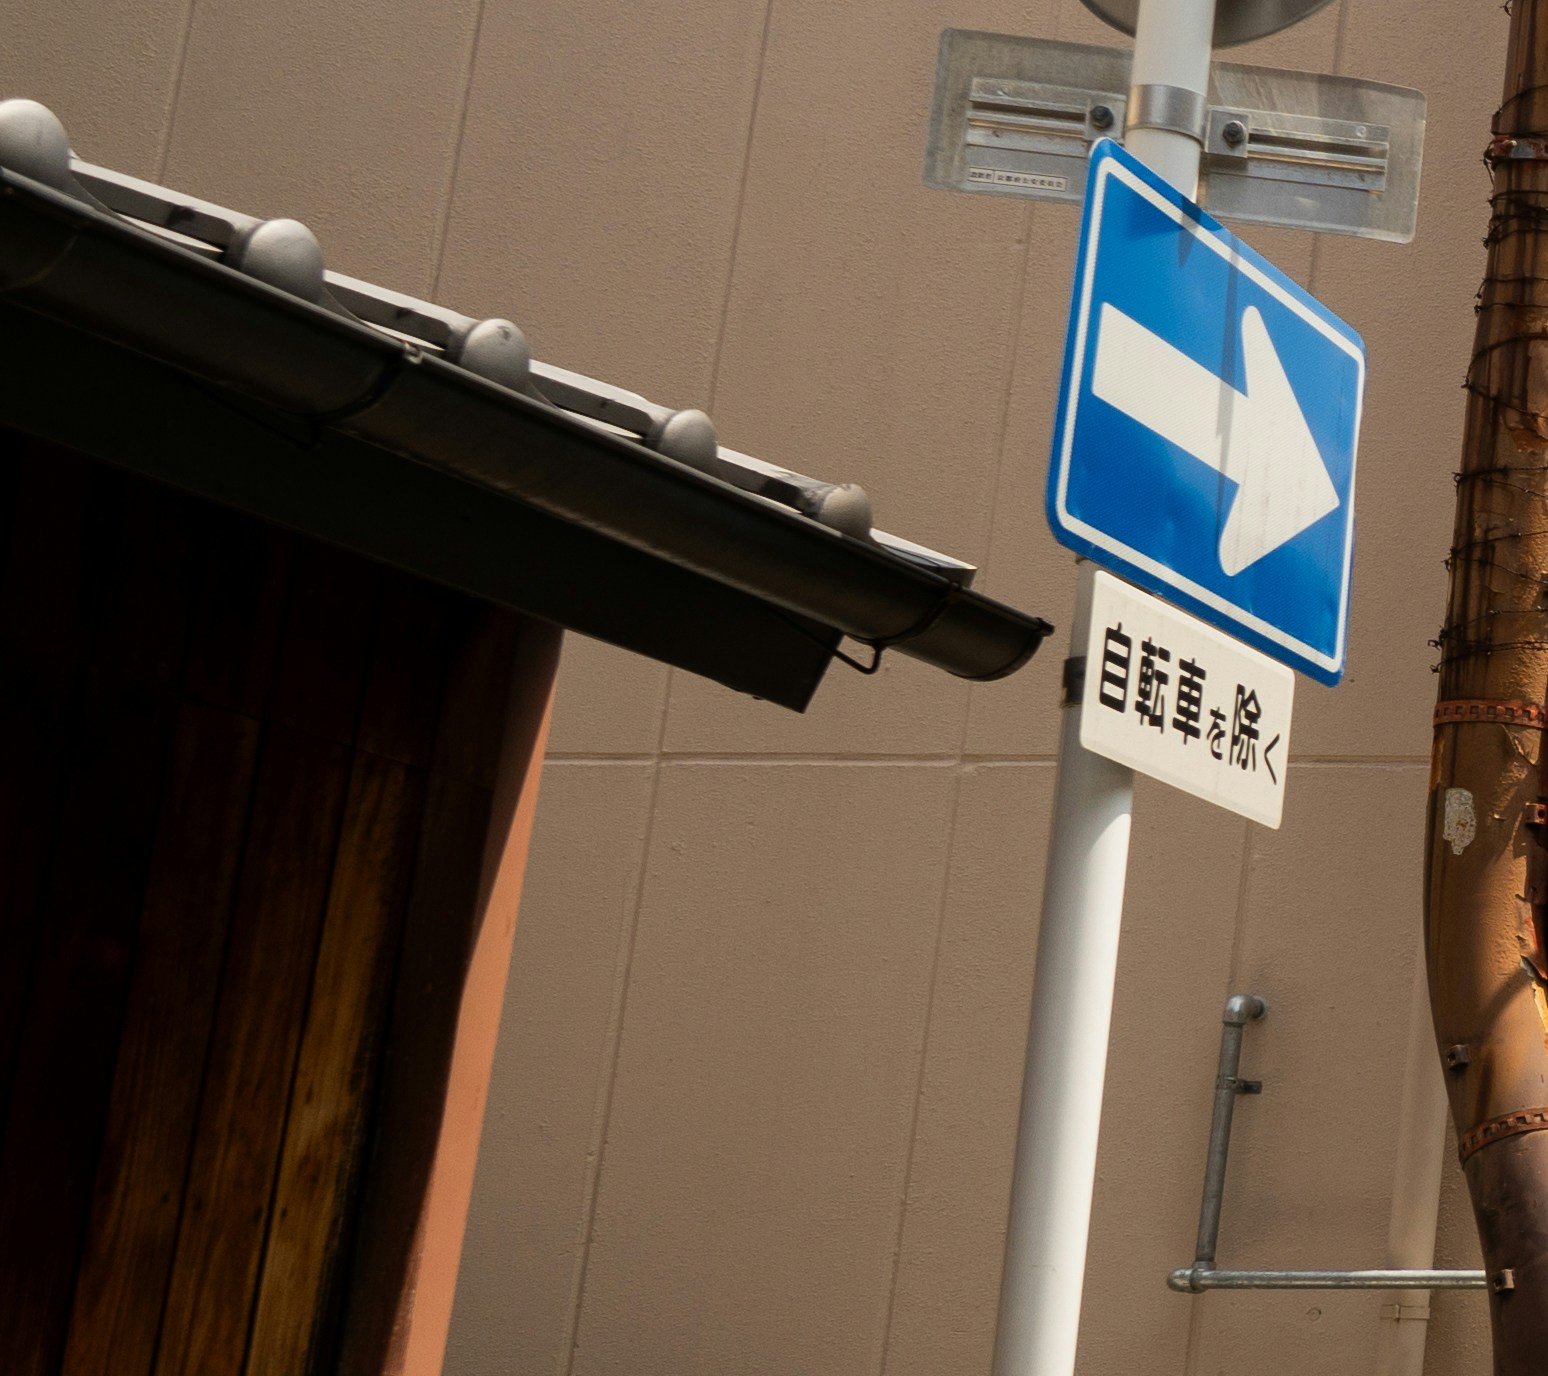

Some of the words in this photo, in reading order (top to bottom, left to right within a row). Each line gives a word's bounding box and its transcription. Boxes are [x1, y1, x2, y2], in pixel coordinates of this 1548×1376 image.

[1097, 620, 1283, 787] 自転車を除く
